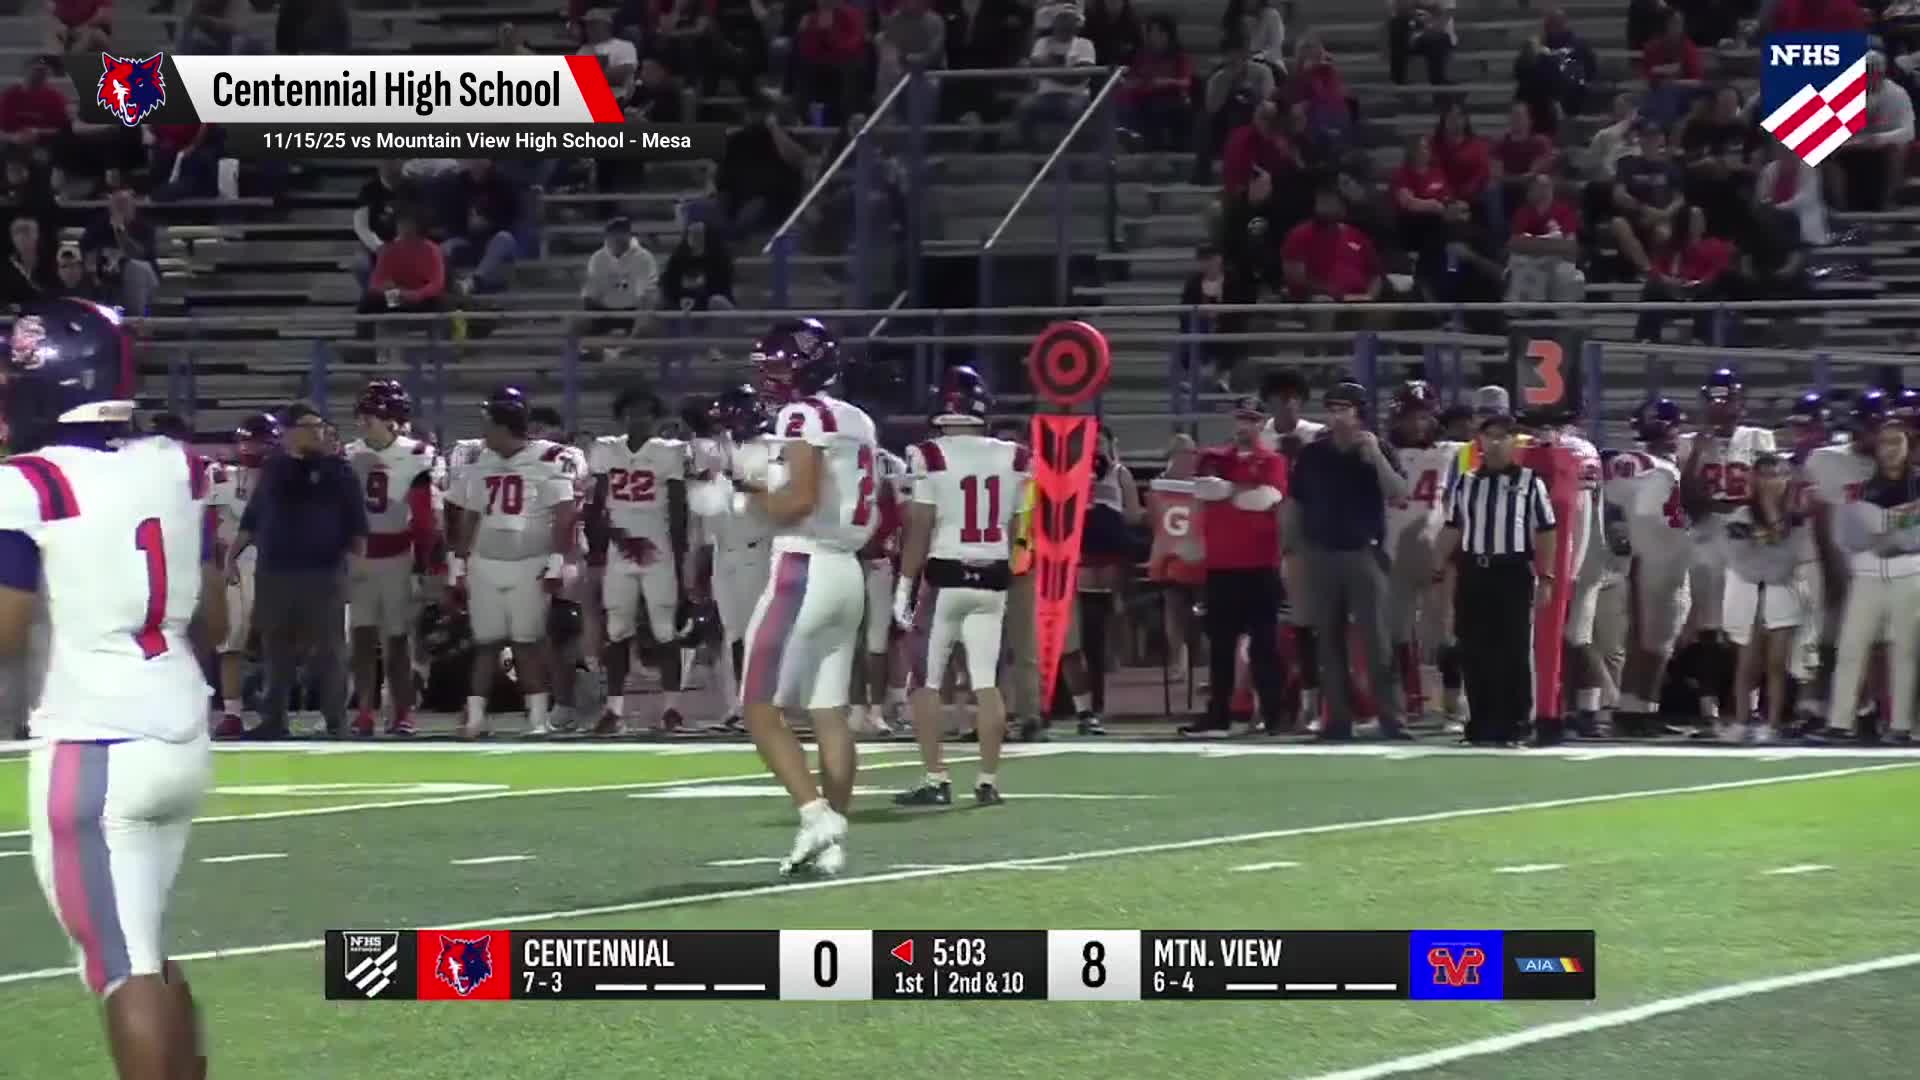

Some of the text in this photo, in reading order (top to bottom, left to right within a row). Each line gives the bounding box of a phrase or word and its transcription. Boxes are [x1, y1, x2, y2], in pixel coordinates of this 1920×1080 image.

[1524, 339, 1564, 405] 3
[786, 412, 805, 437] 2
[484, 474, 524, 516] 70
[610, 468, 656, 502] 22
[959, 475, 1003, 543] 11
[1163, 506, 1191, 537] G
[135, 517, 169, 660] 1
